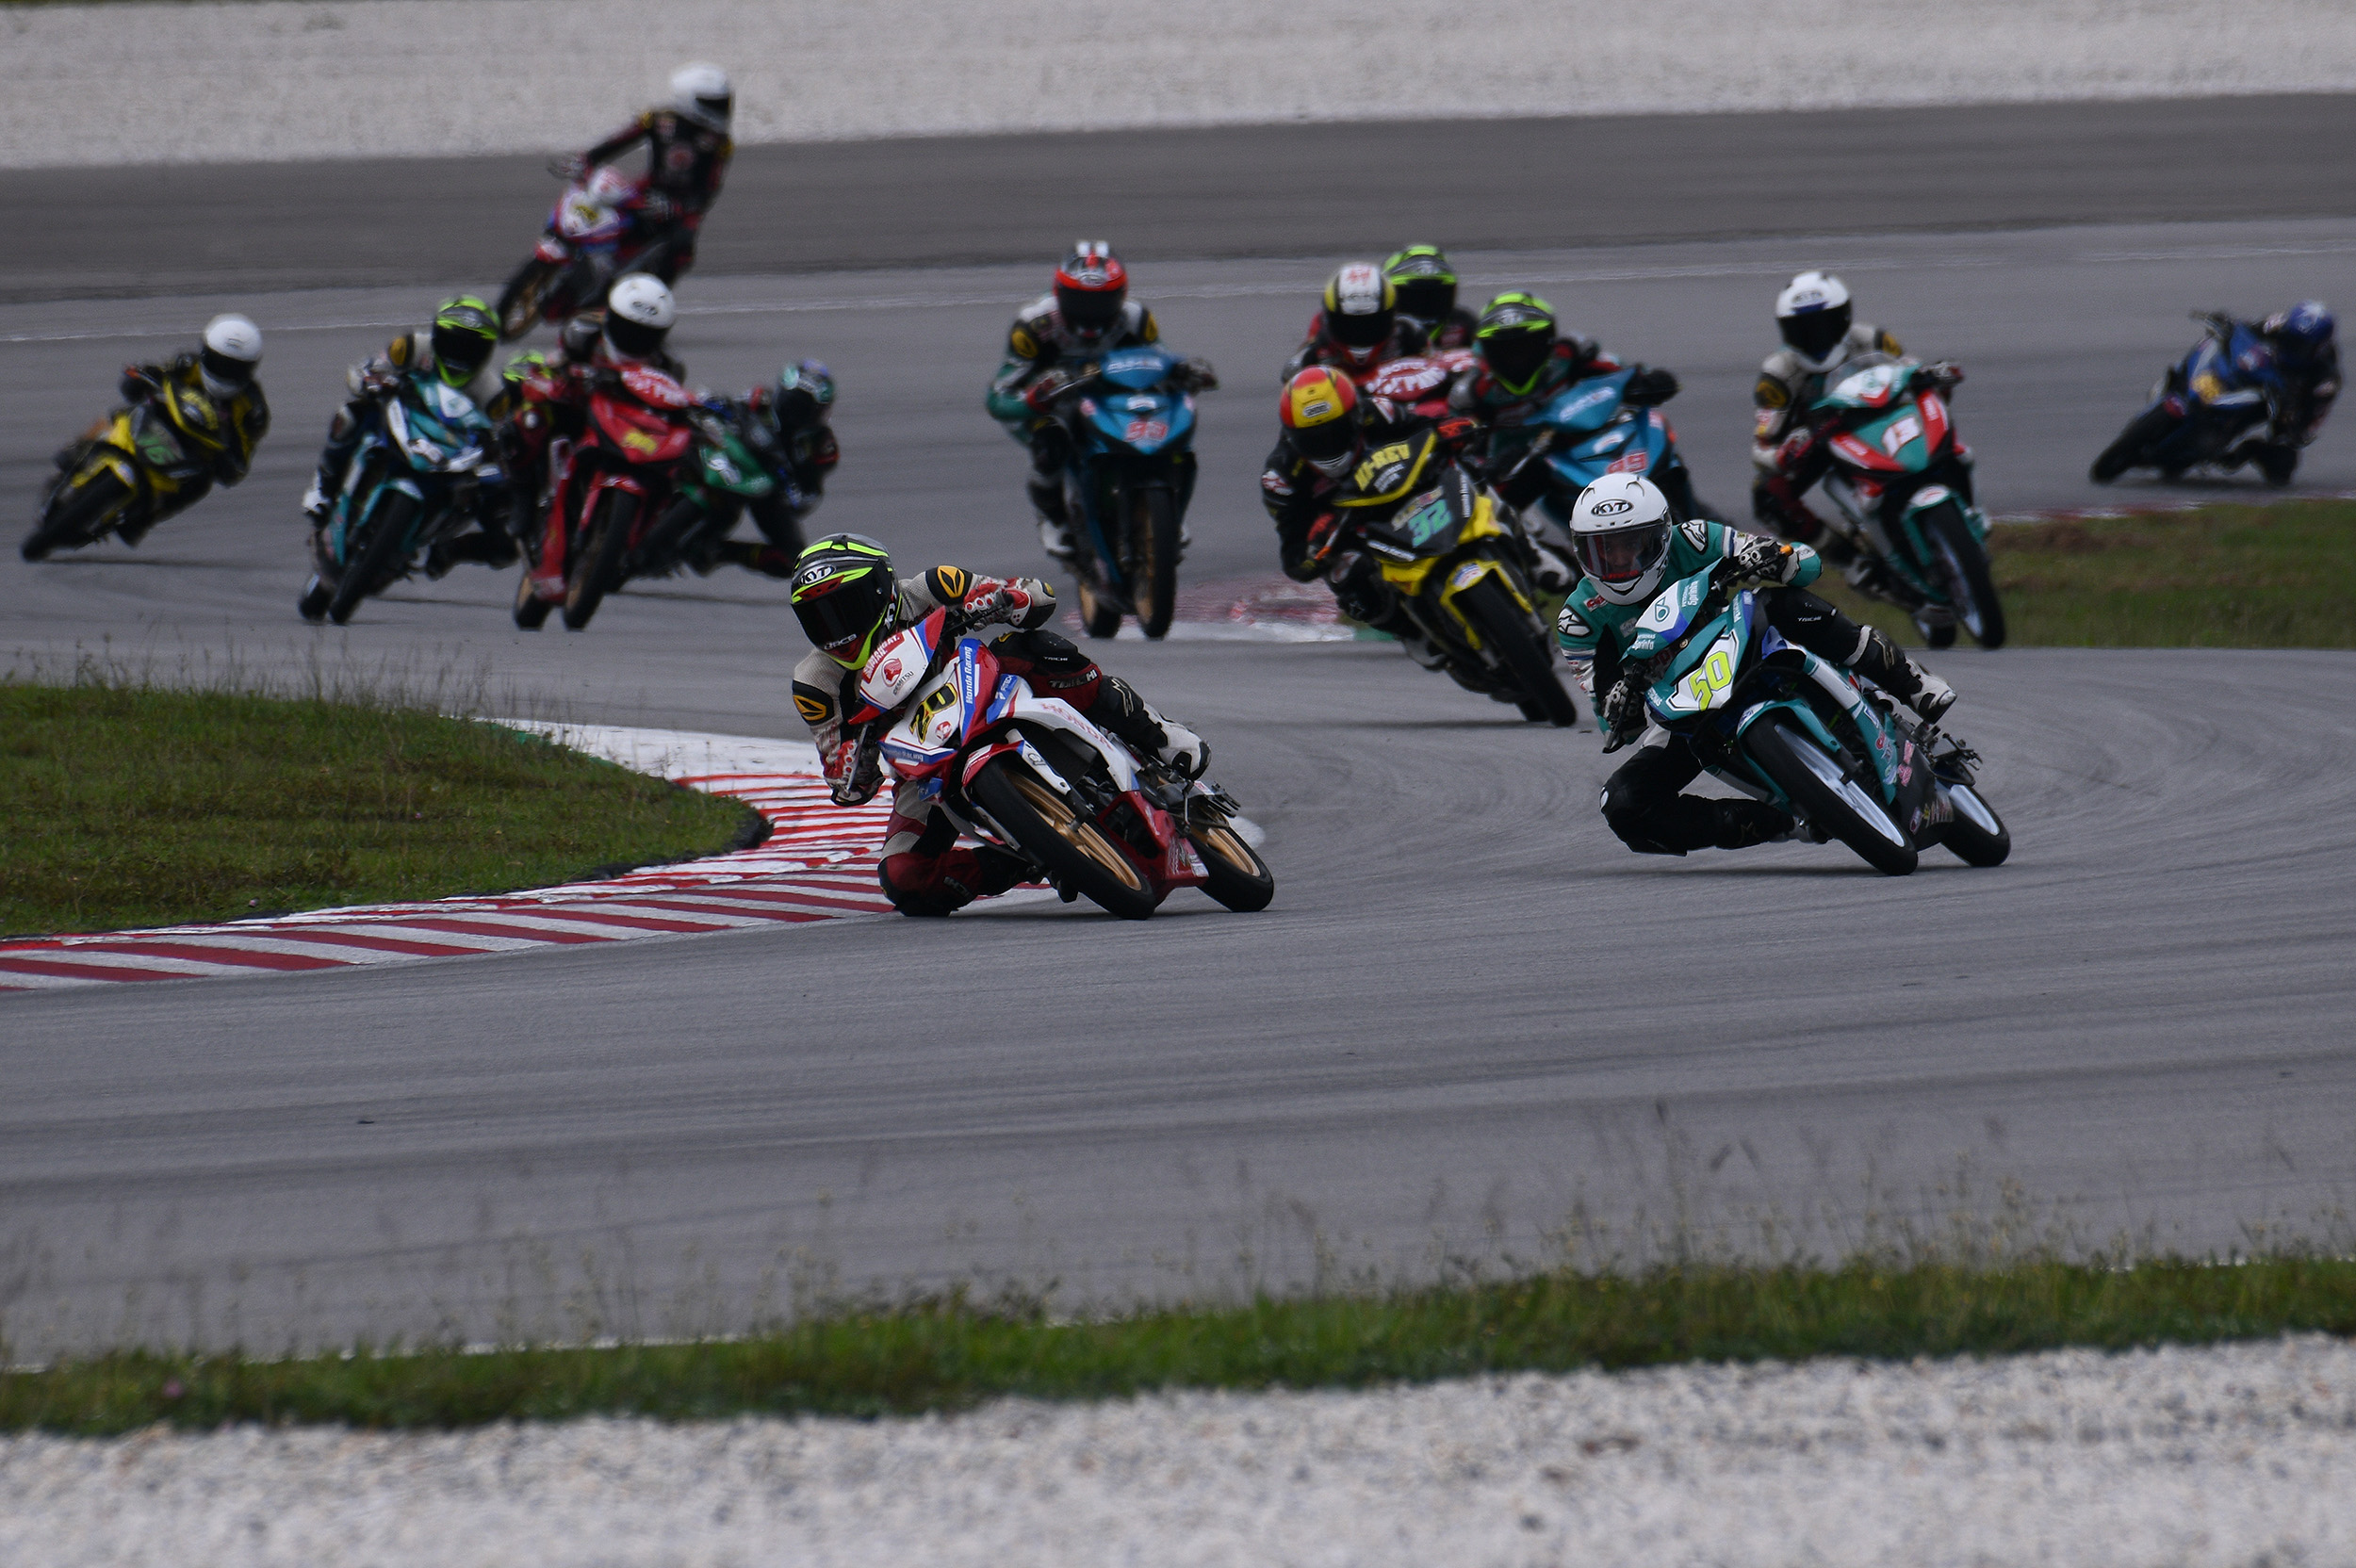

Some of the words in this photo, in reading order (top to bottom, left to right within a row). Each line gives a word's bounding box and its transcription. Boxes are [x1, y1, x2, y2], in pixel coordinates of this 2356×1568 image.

[1593, 500, 1629, 515] KYT
[1407, 498, 1452, 547] 32
[801, 566, 832, 584] KYT
[964, 646, 973, 675] Racing
[964, 676, 974, 705] Honda
[1688, 651, 1732, 711] 50
[908, 682, 958, 744] 20
